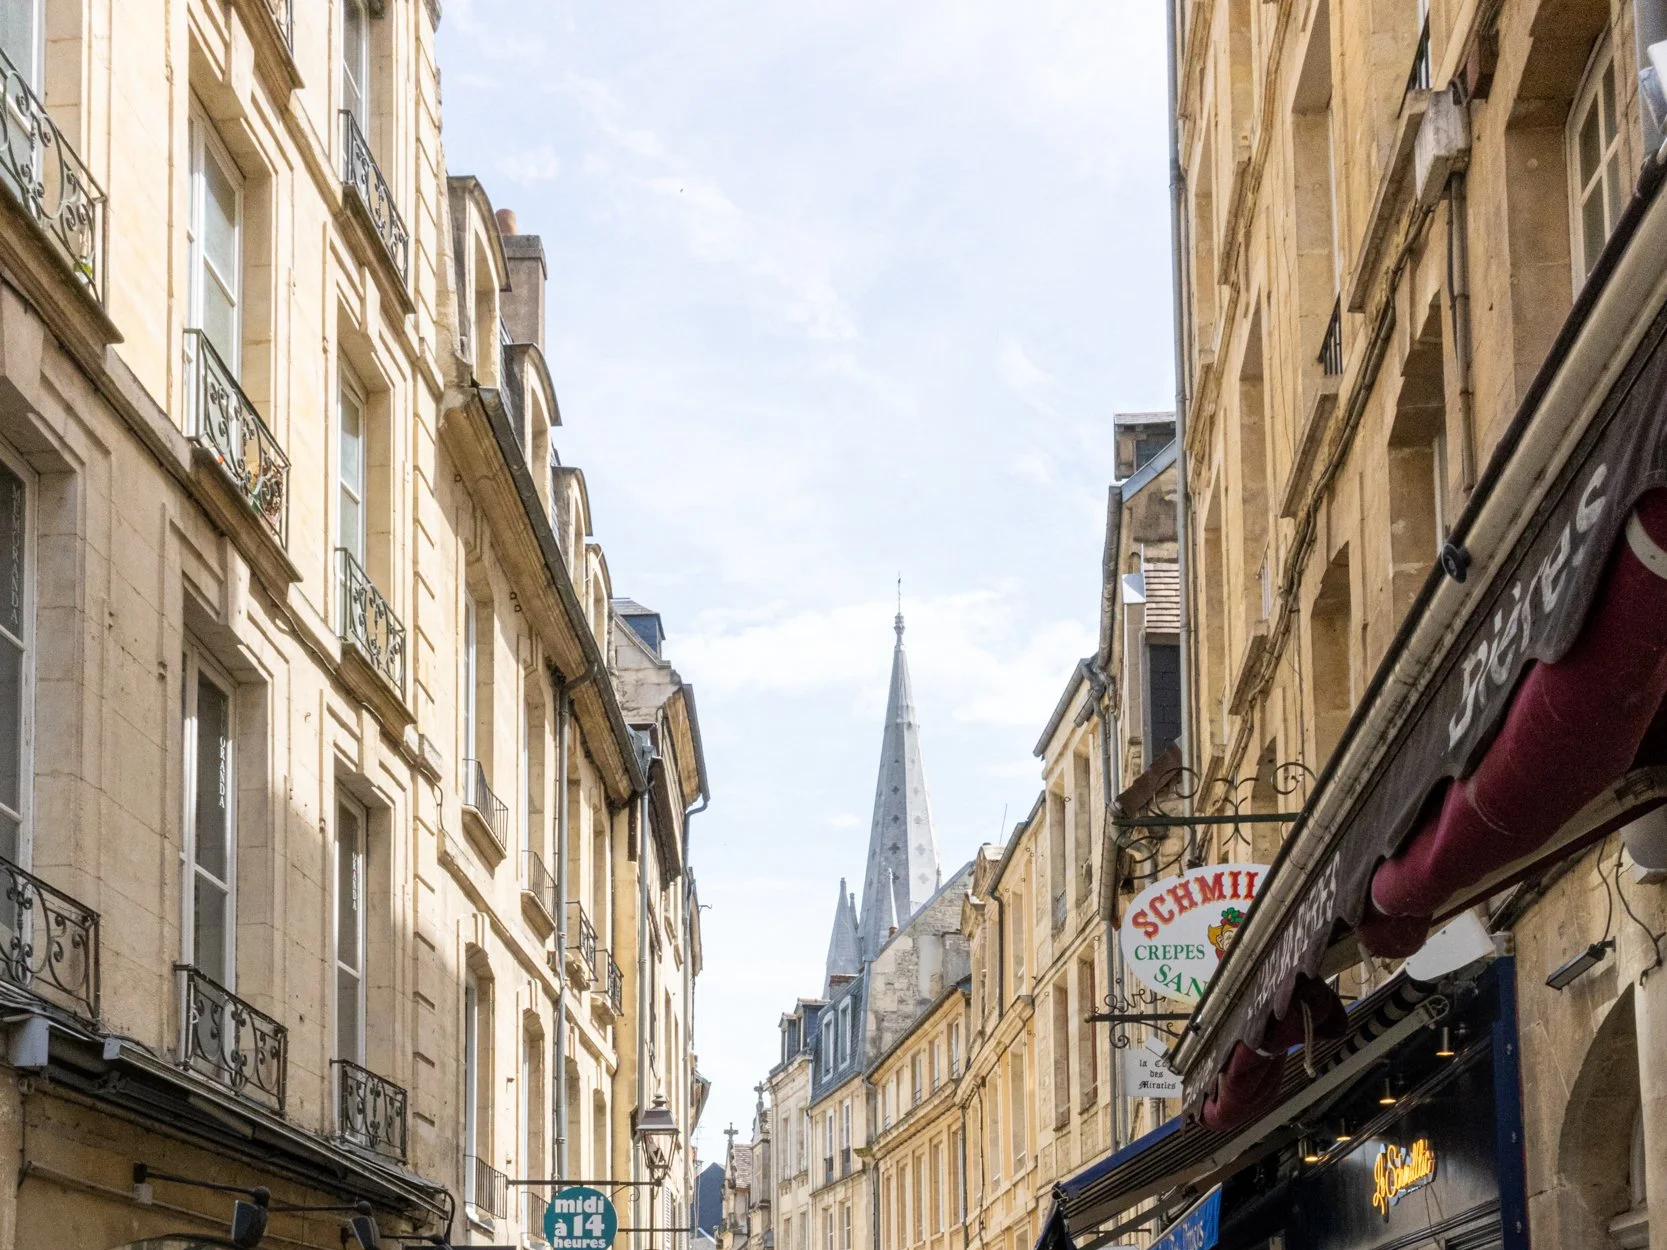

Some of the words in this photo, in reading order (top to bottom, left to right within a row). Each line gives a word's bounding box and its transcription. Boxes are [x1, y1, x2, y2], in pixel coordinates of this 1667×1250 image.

[1134, 943, 1206, 961] CREPES
[1139, 1059, 1148, 1068] la
[1149, 1069, 1164, 1078] des
[1138, 1080, 1177, 1090] Miracles
[554, 1195, 605, 1214] midi
[554, 1218, 568, 1237] à
[573, 1214, 605, 1237] 14
[553, 1236, 607, 1249] heures
